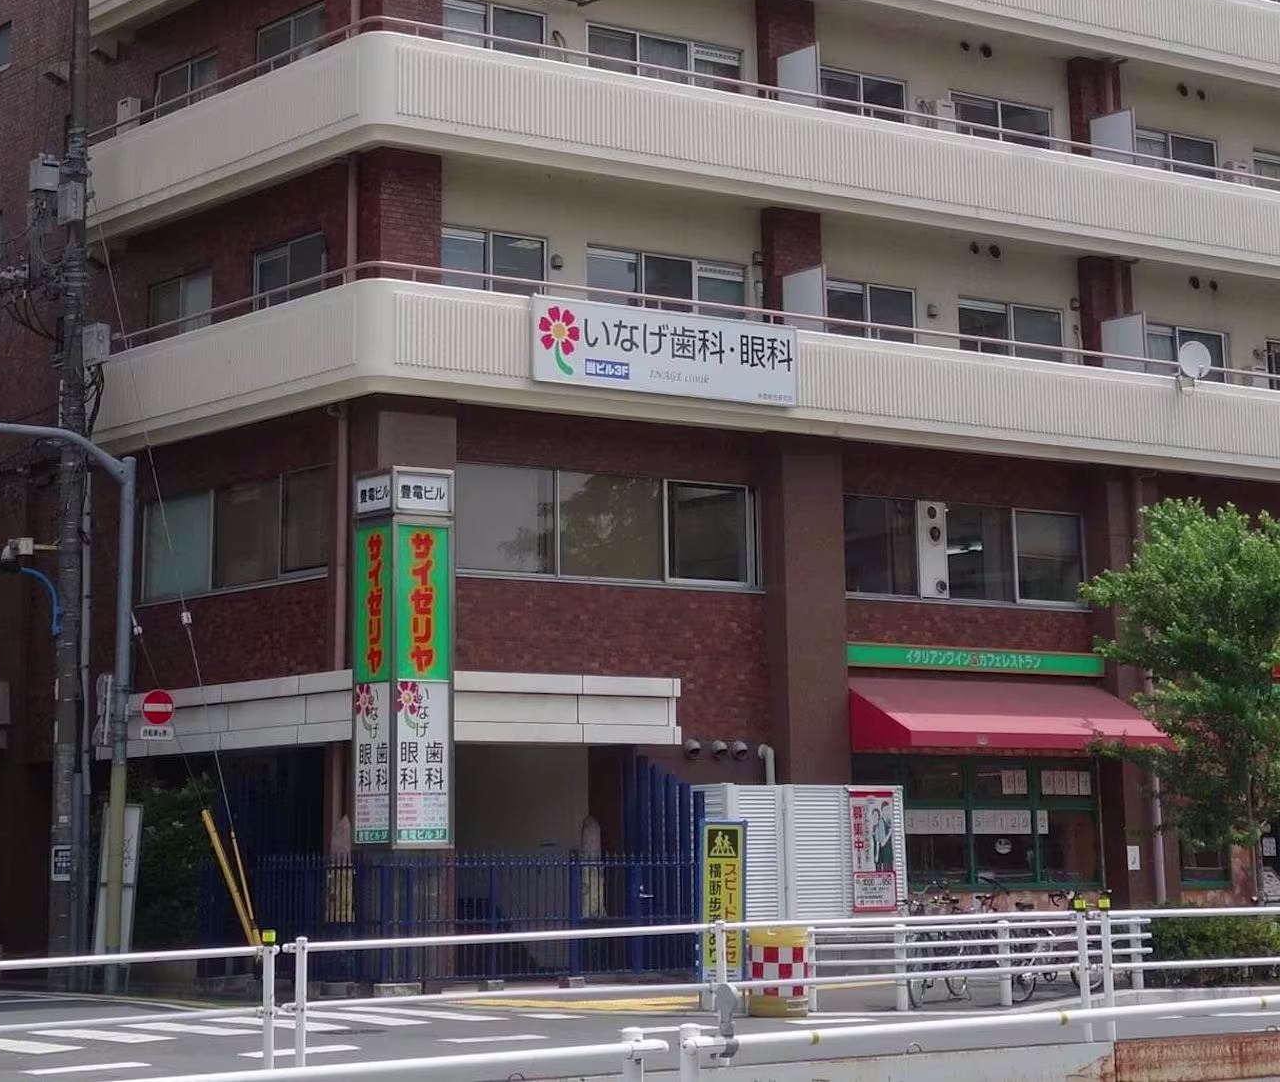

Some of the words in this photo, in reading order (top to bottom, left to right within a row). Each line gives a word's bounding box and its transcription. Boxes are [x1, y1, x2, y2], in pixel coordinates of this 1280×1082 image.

[584, 318, 793, 372] いなげ歯科・眼科
[359, 485, 389, 504] 豊電ビル
[400, 484, 445, 501] 豊電ビル
[367, 532, 383, 674] サイゼリヤ
[410, 532, 434, 674] サイゼリヤ
[358, 743, 372, 792] 眼科
[376, 742, 388, 791] 歯科
[400, 741, 419, 790] 眼科
[425, 741, 444, 790] 歯科
[709, 863, 721, 964] 横断歩あり
[724, 863, 737, 964] スピードとせ
